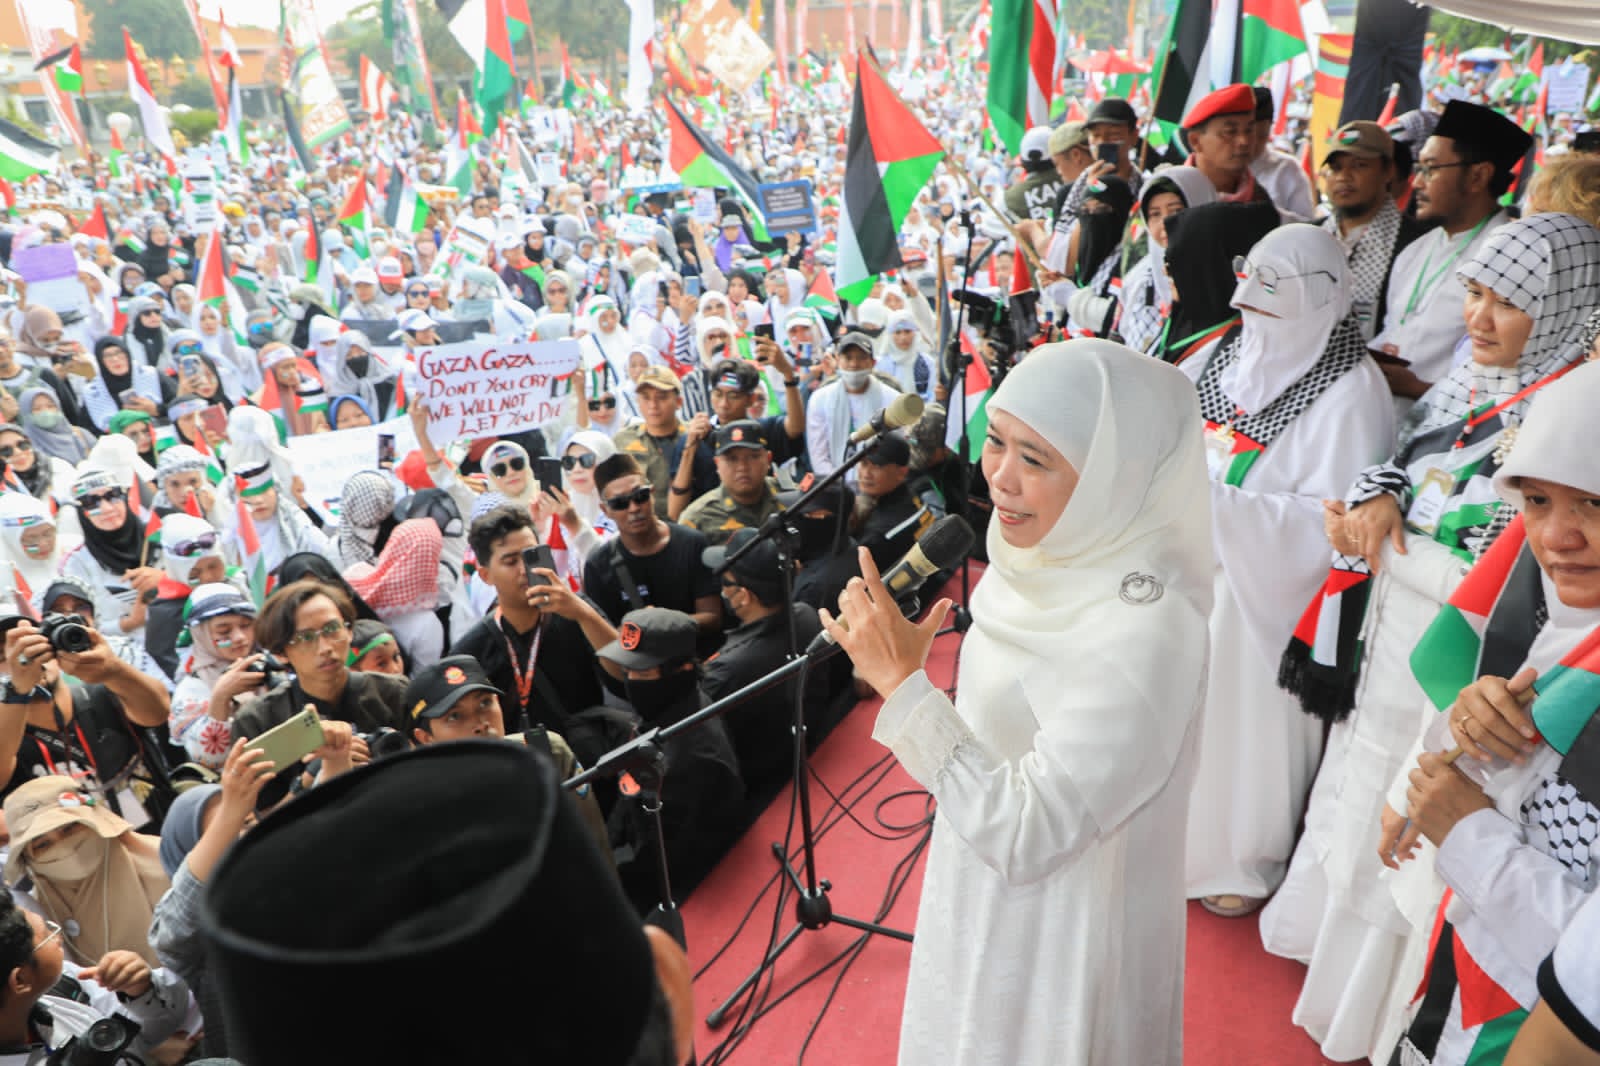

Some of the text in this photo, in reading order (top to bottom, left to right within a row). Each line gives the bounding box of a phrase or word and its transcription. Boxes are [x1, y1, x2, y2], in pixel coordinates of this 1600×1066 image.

[419, 350, 478, 379] GAZA
[430, 374, 551, 398] DONT YOU CRY
[427, 392, 531, 422] WE WILL NOT
[458, 413, 502, 436] LET
[506, 410, 535, 428] YOU
